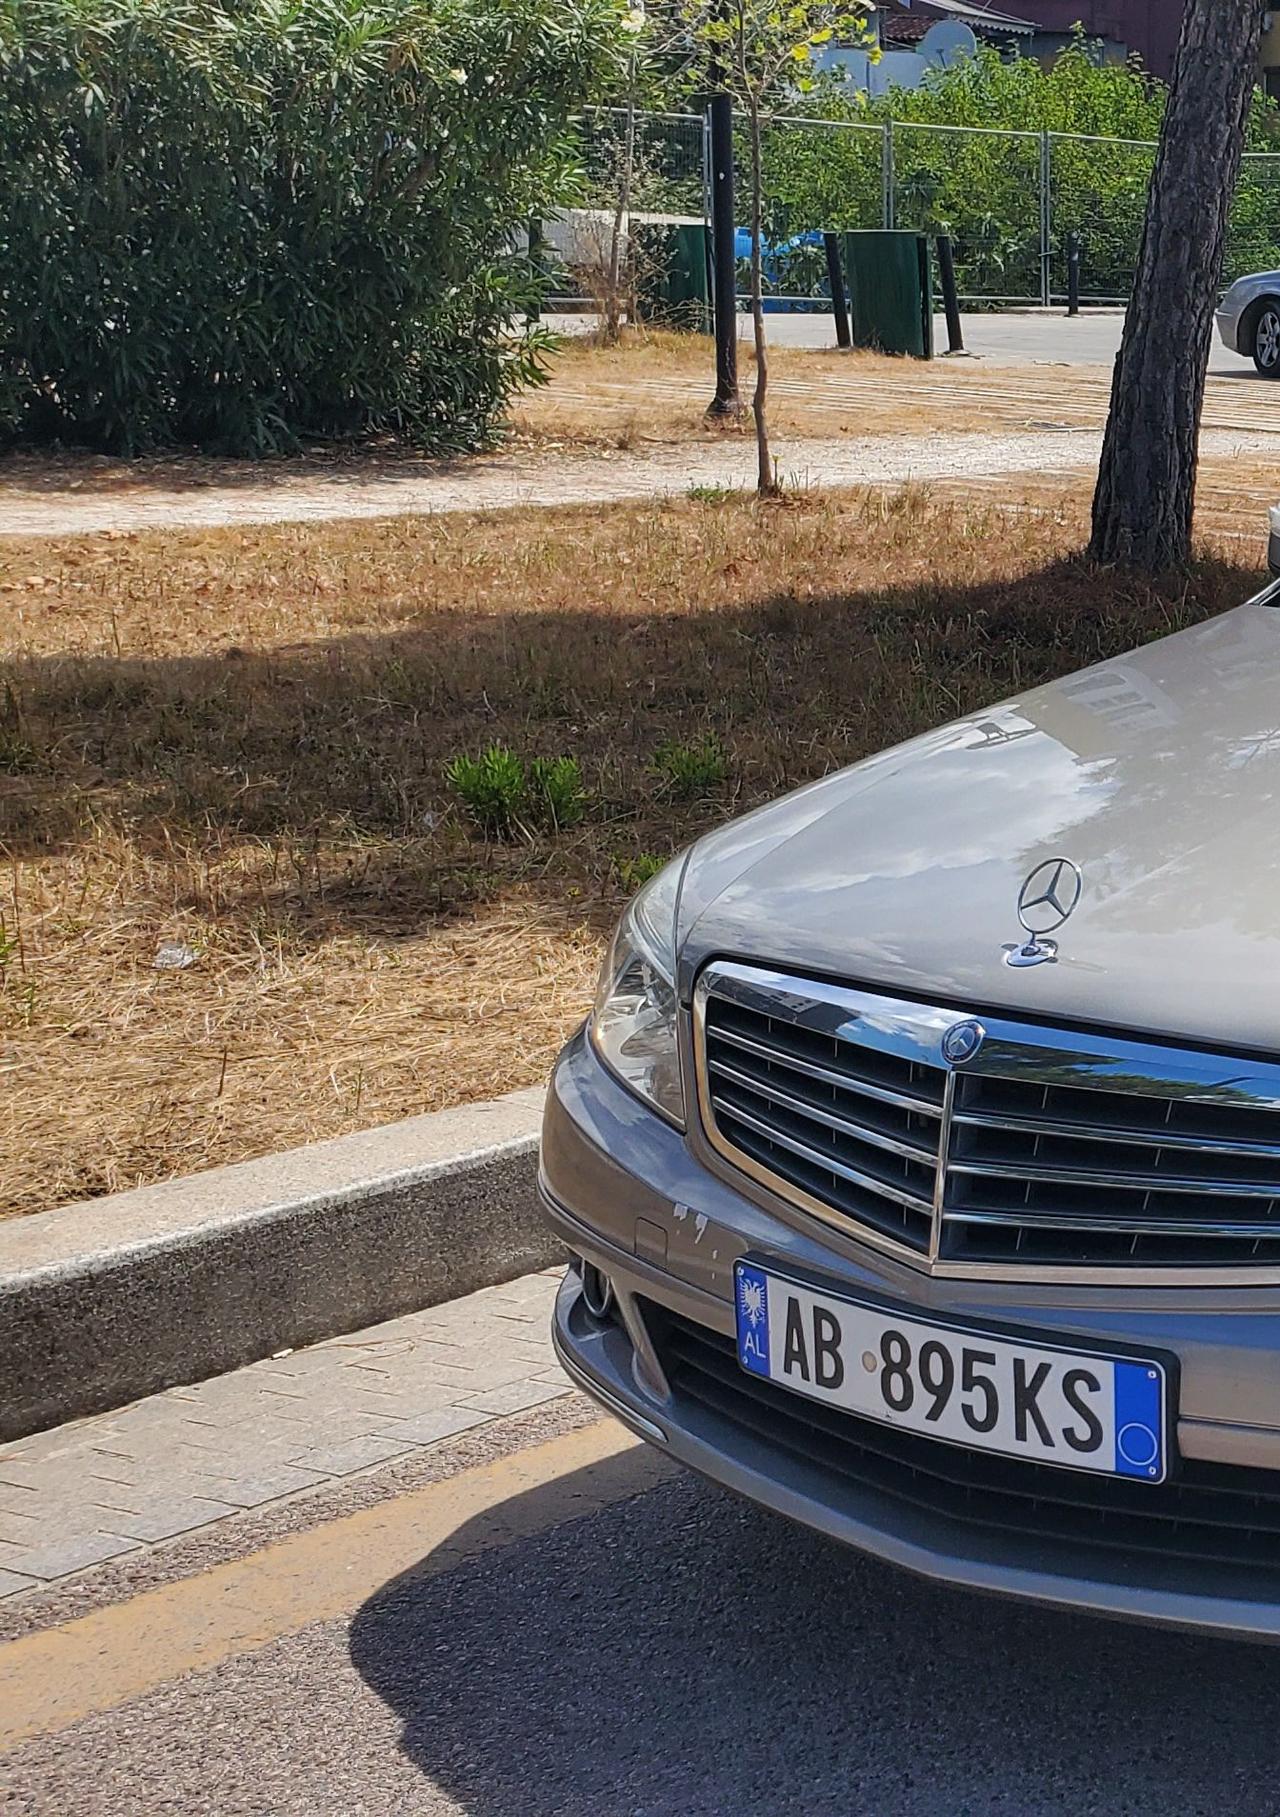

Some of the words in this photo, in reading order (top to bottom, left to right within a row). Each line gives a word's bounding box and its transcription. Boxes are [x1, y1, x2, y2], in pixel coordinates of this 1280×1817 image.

[744, 1331, 766, 1358] AL
[783, 1296, 844, 1389] AB
[880, 1330, 1104, 1453] 895KS
